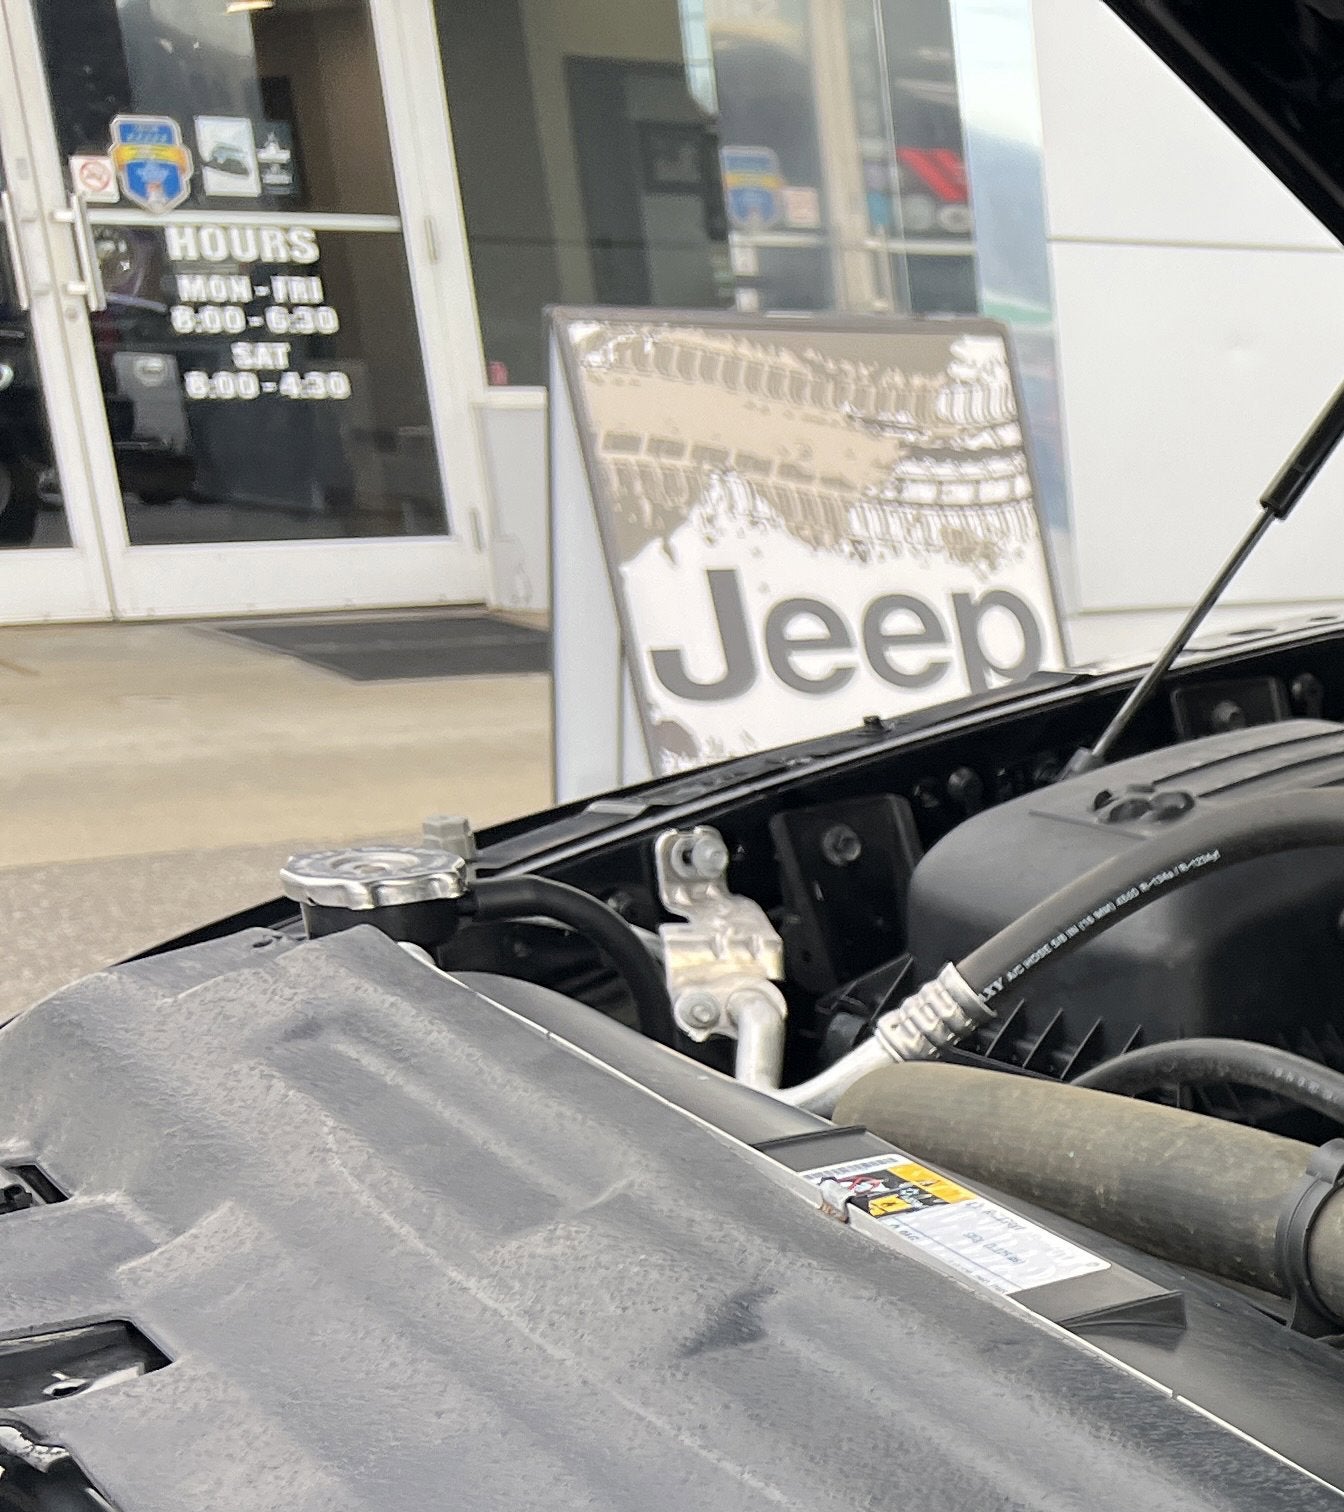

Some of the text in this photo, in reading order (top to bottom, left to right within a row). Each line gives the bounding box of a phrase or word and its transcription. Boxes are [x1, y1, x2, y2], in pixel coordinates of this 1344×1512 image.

[165, 225, 320, 264] HOURS
[230, 341, 291, 370] SAT
[649, 569, 1041, 700] Jeep
